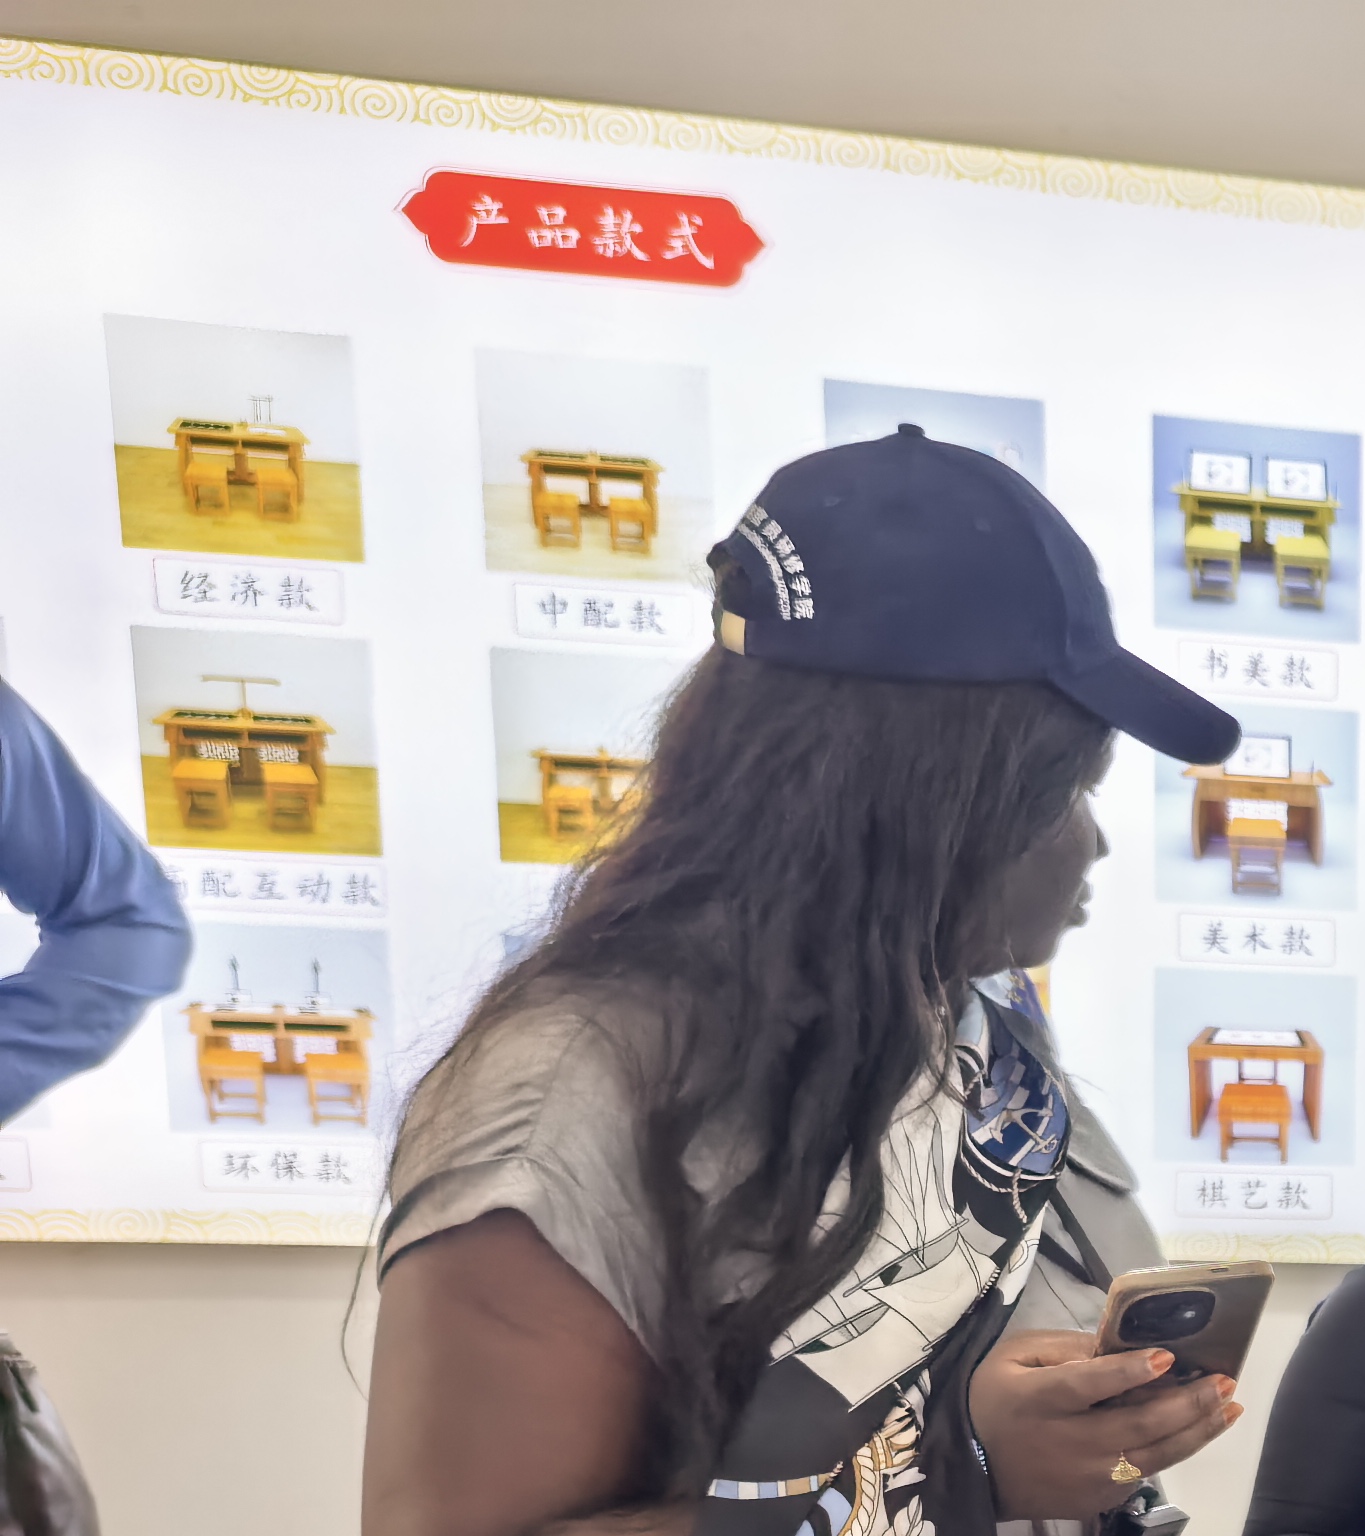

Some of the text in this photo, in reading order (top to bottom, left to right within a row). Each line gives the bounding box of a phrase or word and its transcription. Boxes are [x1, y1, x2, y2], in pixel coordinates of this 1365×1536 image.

[458, 193, 717, 272] 产品款式
[179, 569, 322, 614] 经济款
[536, 591, 668, 637] 中配款
[1202, 646, 1317, 691] 书美款
[1202, 922, 1315, 959] 美术款
[222, 1151, 353, 1186] 环保款
[1196, 1178, 1313, 1213] 棋艺款
